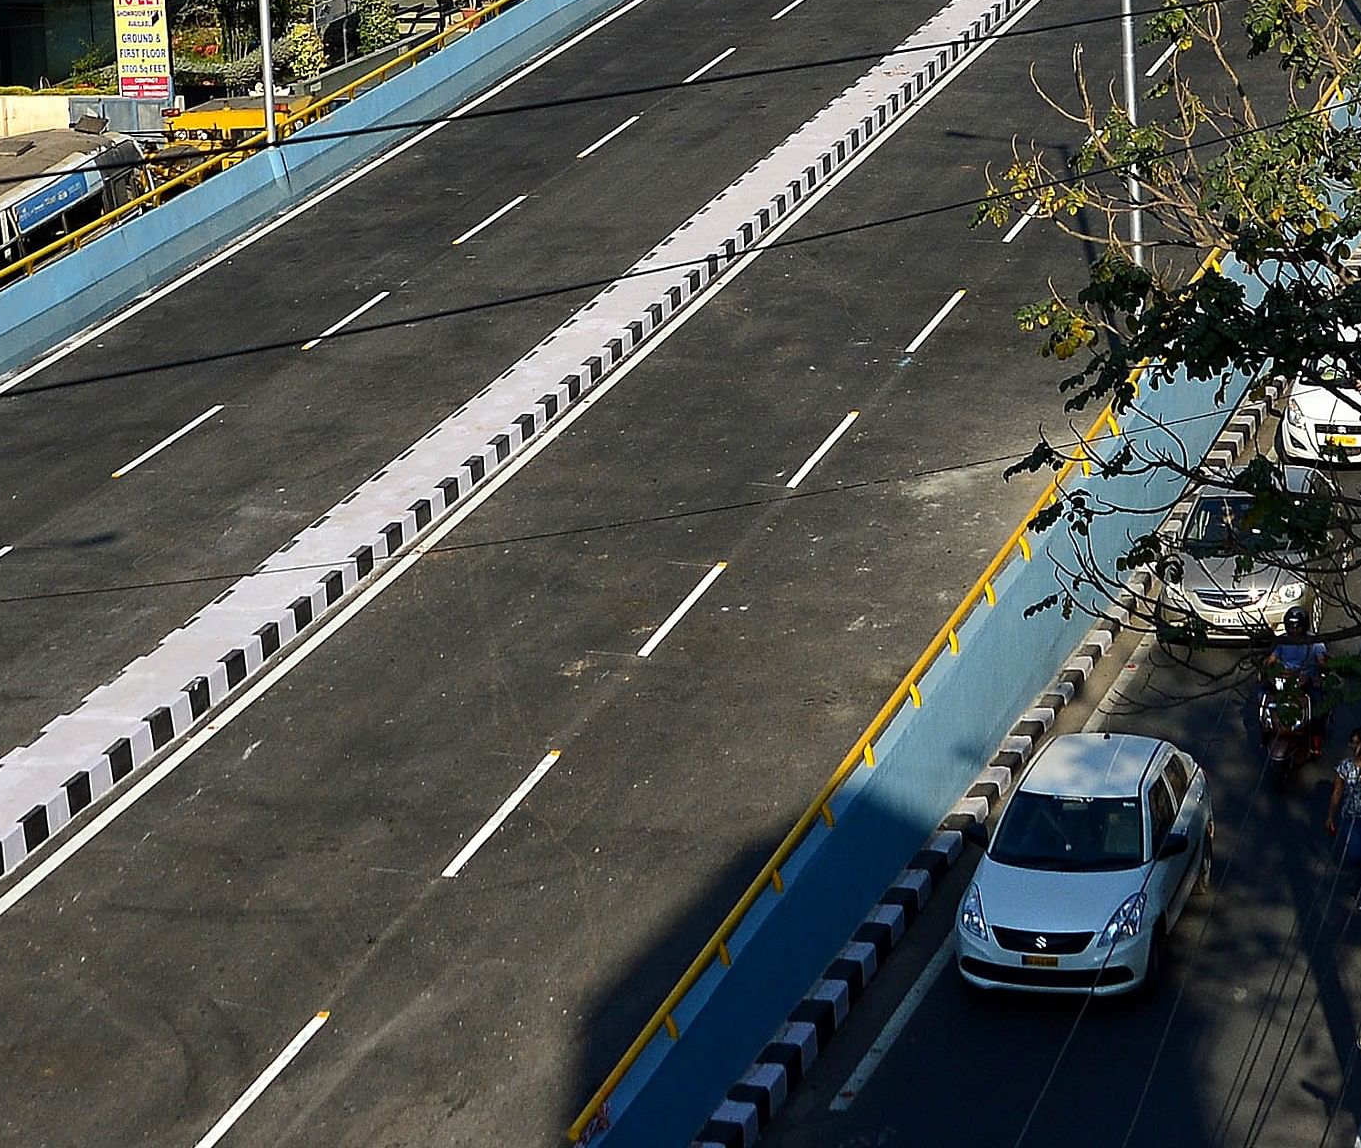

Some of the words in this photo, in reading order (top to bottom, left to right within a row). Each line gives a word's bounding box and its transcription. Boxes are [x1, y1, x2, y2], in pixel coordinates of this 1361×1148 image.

[122, 34, 153, 43] GROUND
[120, 49, 140, 58] FIRST
[142, 49, 166, 58] FLOOR
[150, 64, 166, 73] FEET
